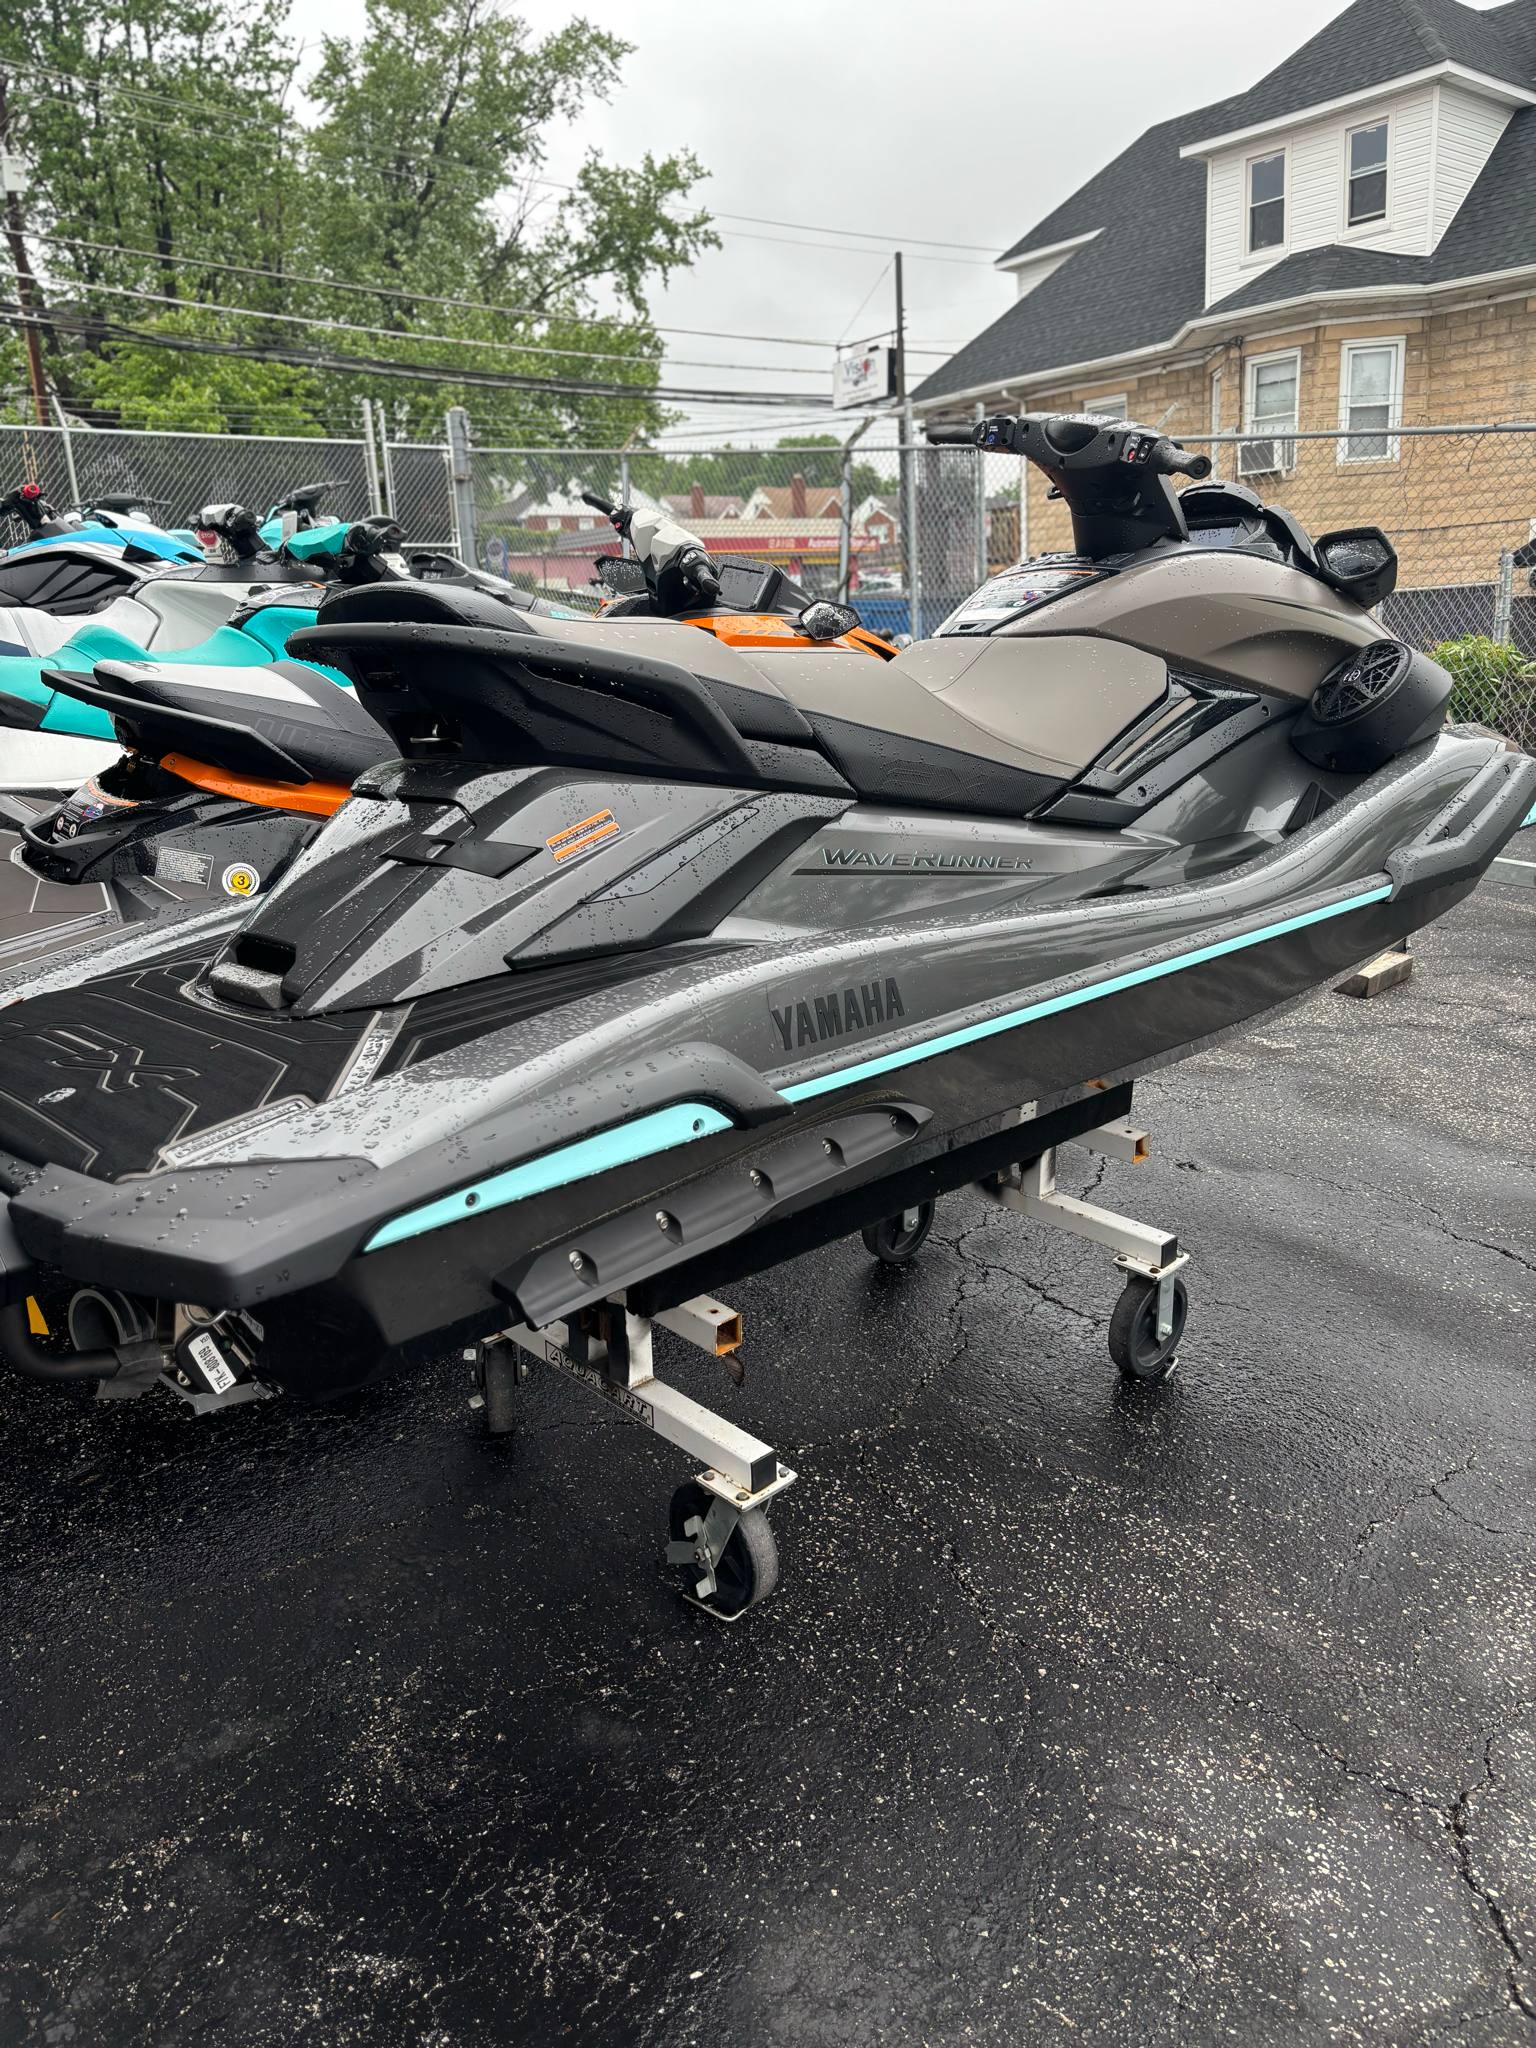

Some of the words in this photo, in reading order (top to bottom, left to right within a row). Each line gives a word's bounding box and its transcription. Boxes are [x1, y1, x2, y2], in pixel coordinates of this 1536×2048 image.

[821, 848, 1033, 870] WAVERUNNER
[237, 875, 246, 885] 3
[771, 976, 905, 1051] YAMAHA
